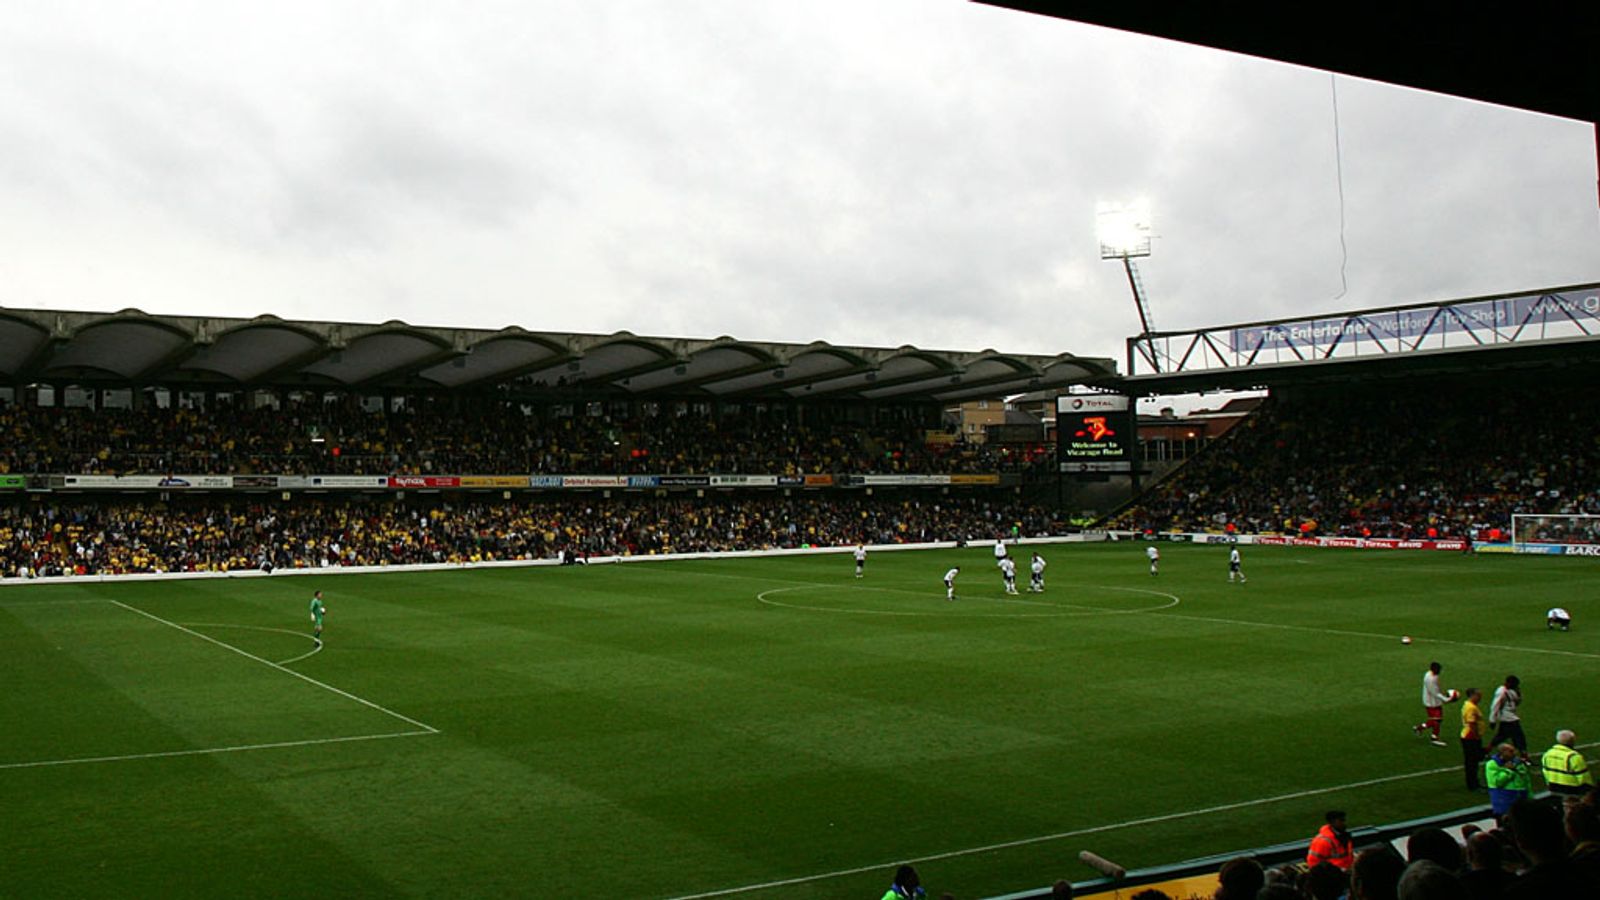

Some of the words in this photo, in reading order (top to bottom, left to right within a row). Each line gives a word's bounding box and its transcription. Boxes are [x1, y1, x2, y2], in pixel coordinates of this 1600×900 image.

[1263, 329, 1286, 342] The
[1290, 322, 1371, 338] Entertainer
[1379, 316, 1440, 331] Watford's
[1445, 312, 1467, 327] Toy
[1471, 309, 1504, 324] Shop
[1071, 441, 1107, 449] Welcome
